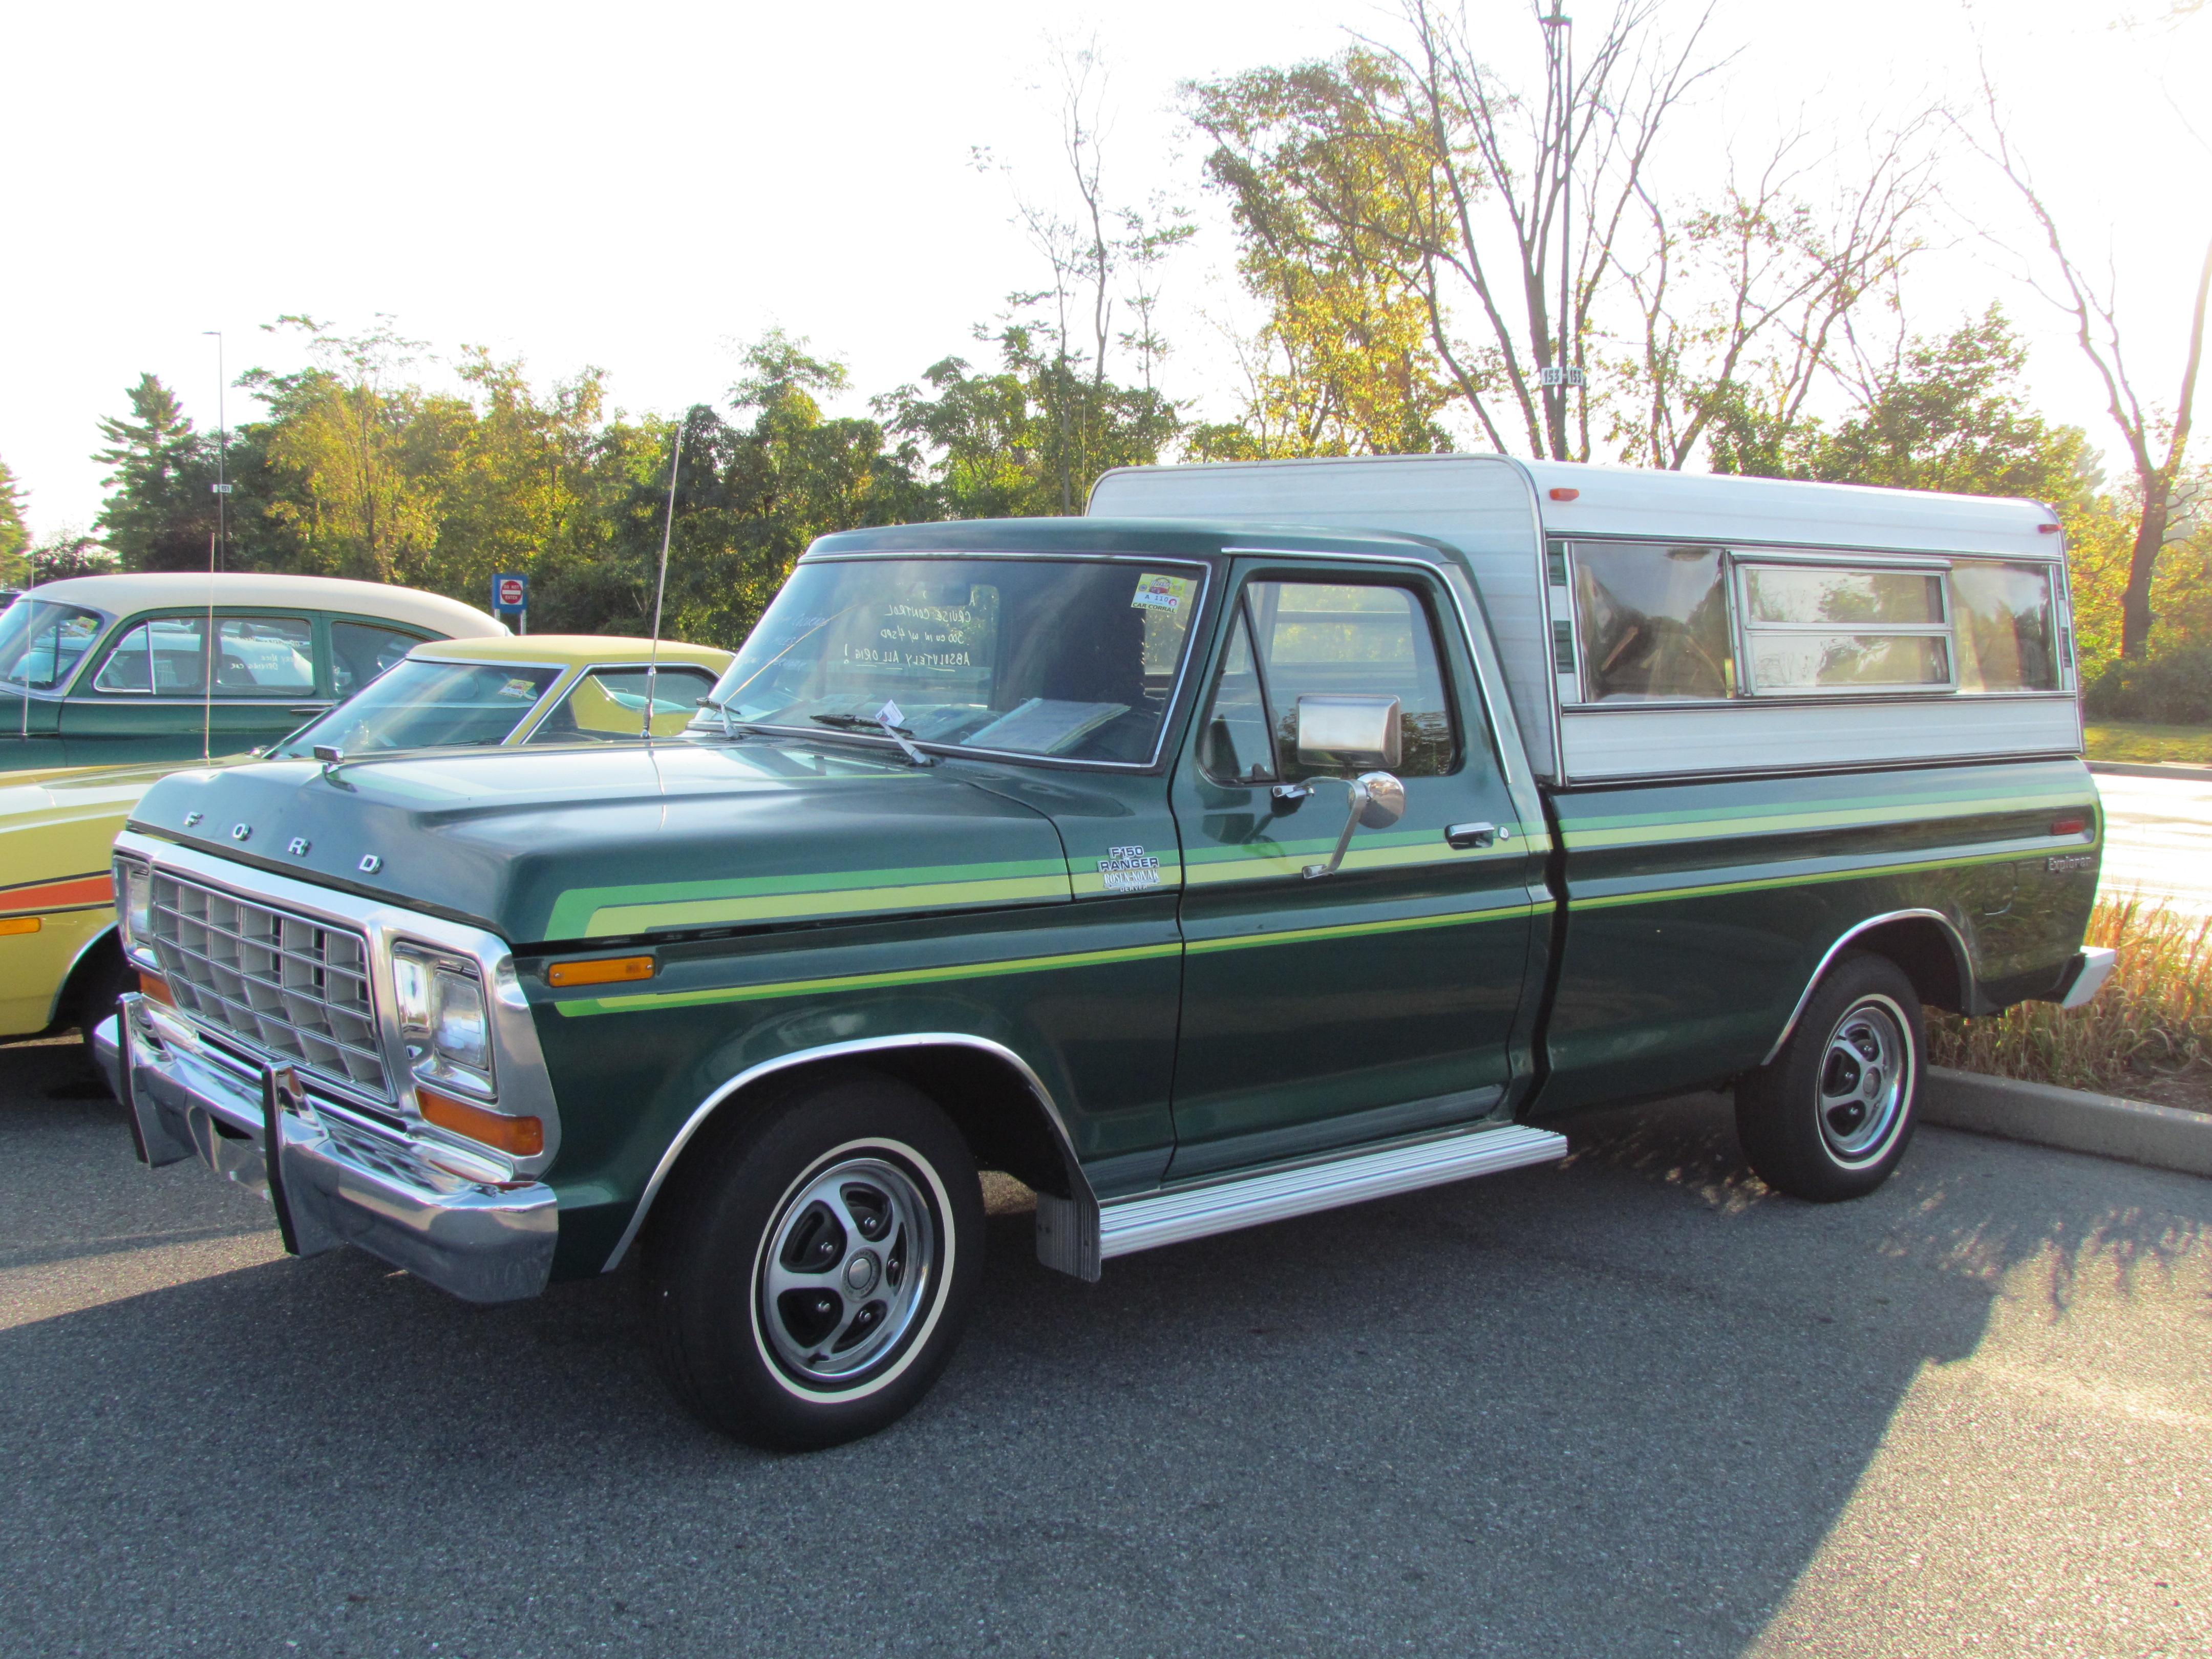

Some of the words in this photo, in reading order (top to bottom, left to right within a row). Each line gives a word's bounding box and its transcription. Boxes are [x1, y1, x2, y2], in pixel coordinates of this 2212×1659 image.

[1544, 369, 1560, 384] 153
[1569, 370, 1582, 384] 153
[1147, 604, 1176, 613] CORRAL
[183, 811, 382, 875] FORD
[1110, 846, 1144, 858] F150
[1099, 857, 1159, 871] RANGER
[2048, 856, 2091, 872] Explorer
[1103, 869, 1159, 884] ROSEN-NOVAK
